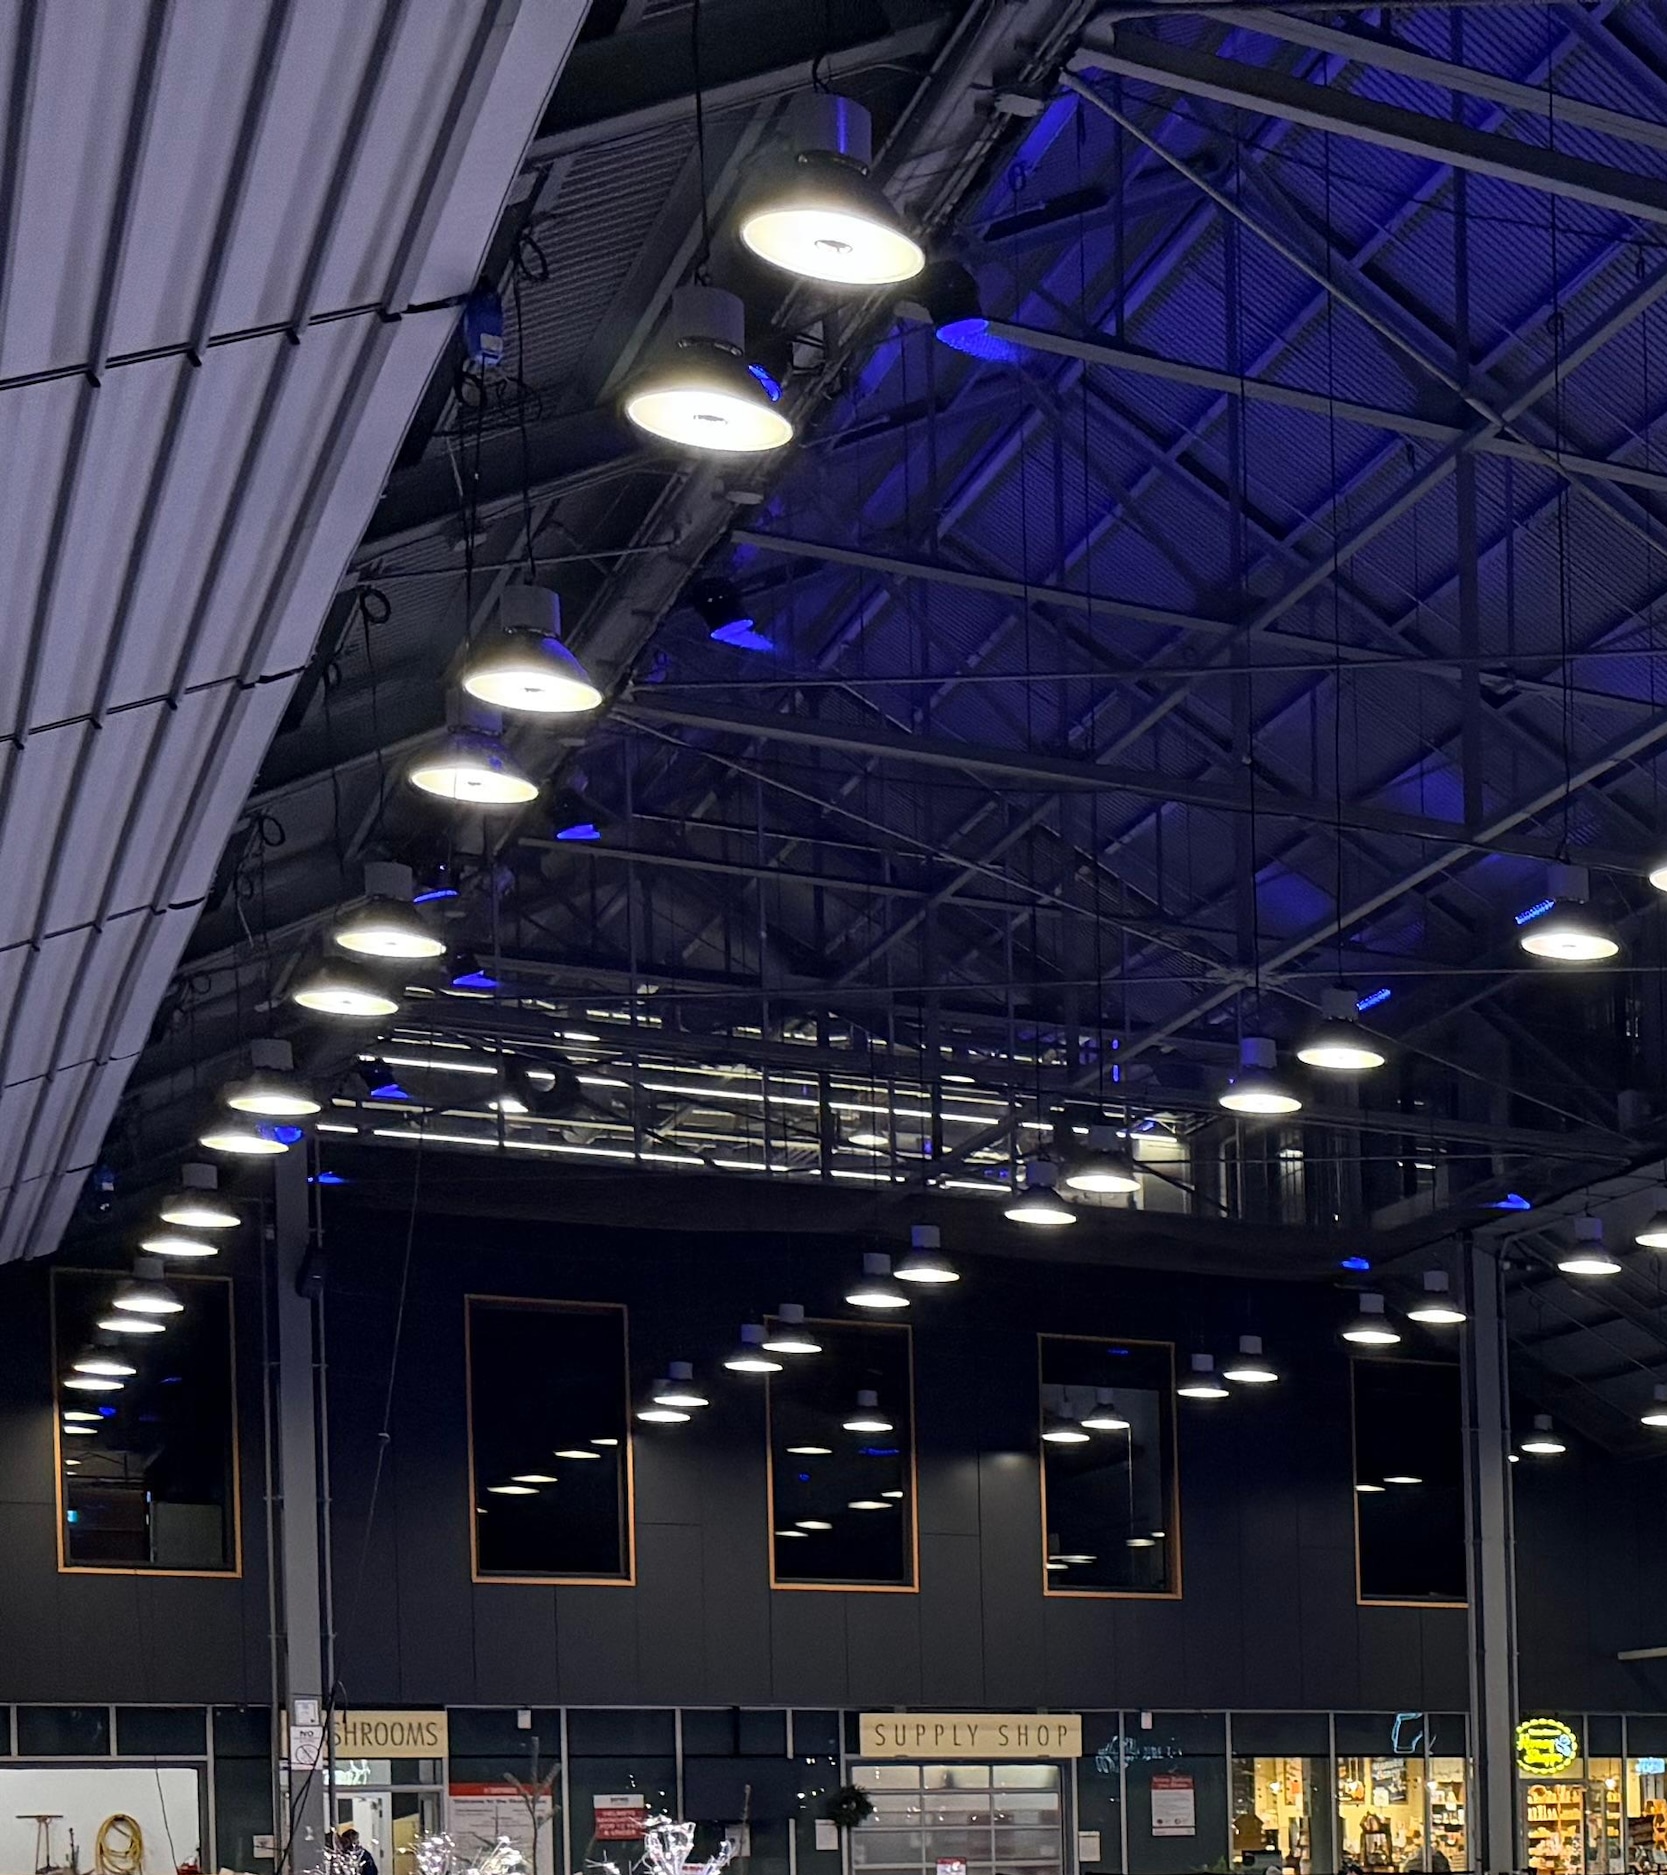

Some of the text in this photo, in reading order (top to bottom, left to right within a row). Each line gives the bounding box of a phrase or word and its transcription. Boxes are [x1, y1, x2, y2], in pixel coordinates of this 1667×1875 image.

[299, 1730, 315, 1738] NO
[874, 1723, 1068, 1747] SUPPLY SHOP
